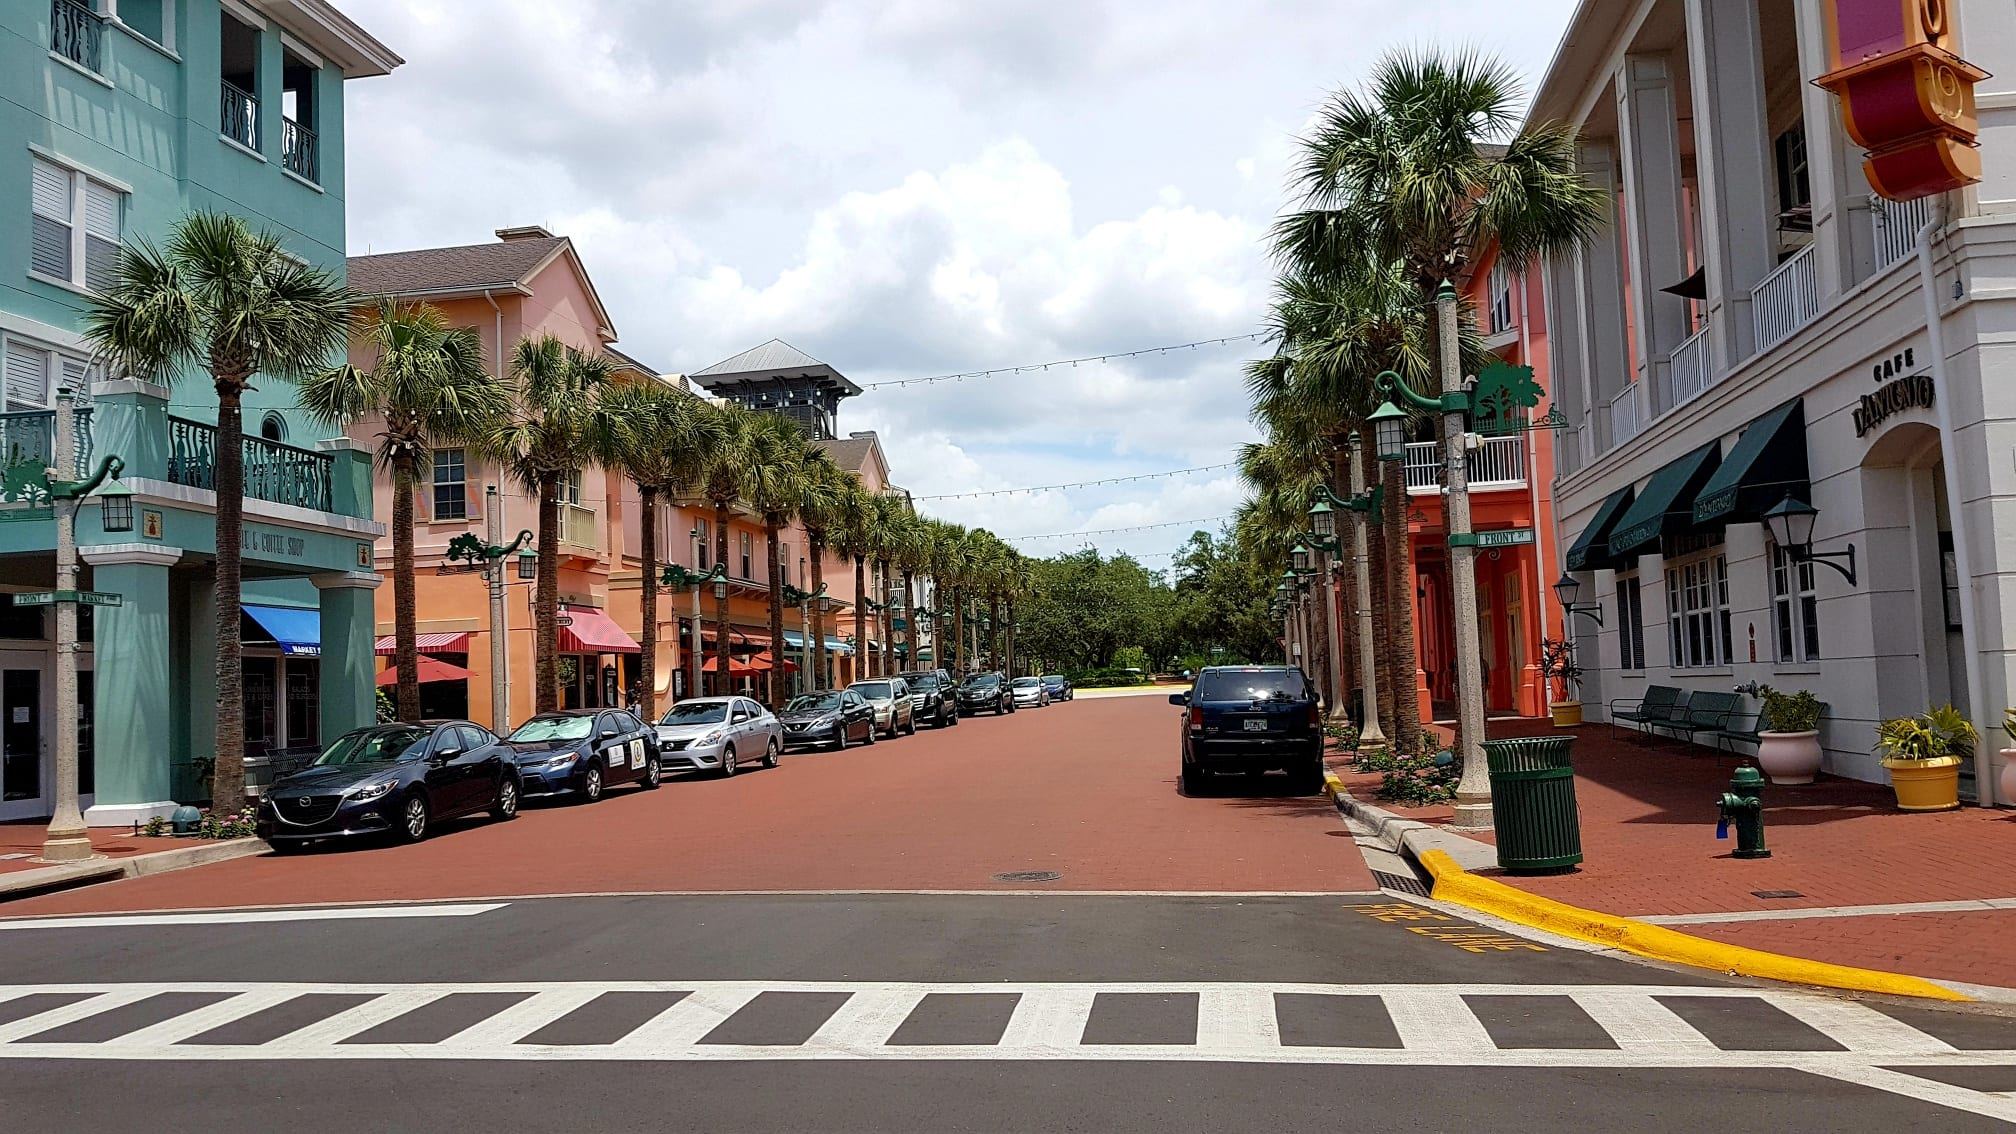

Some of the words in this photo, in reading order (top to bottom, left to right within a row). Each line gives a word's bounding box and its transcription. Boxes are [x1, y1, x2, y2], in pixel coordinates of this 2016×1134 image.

[1873, 348, 1914, 382] CAFE
[1485, 531, 1514, 545] FRONT
[292, 645, 317, 654] MARKET
